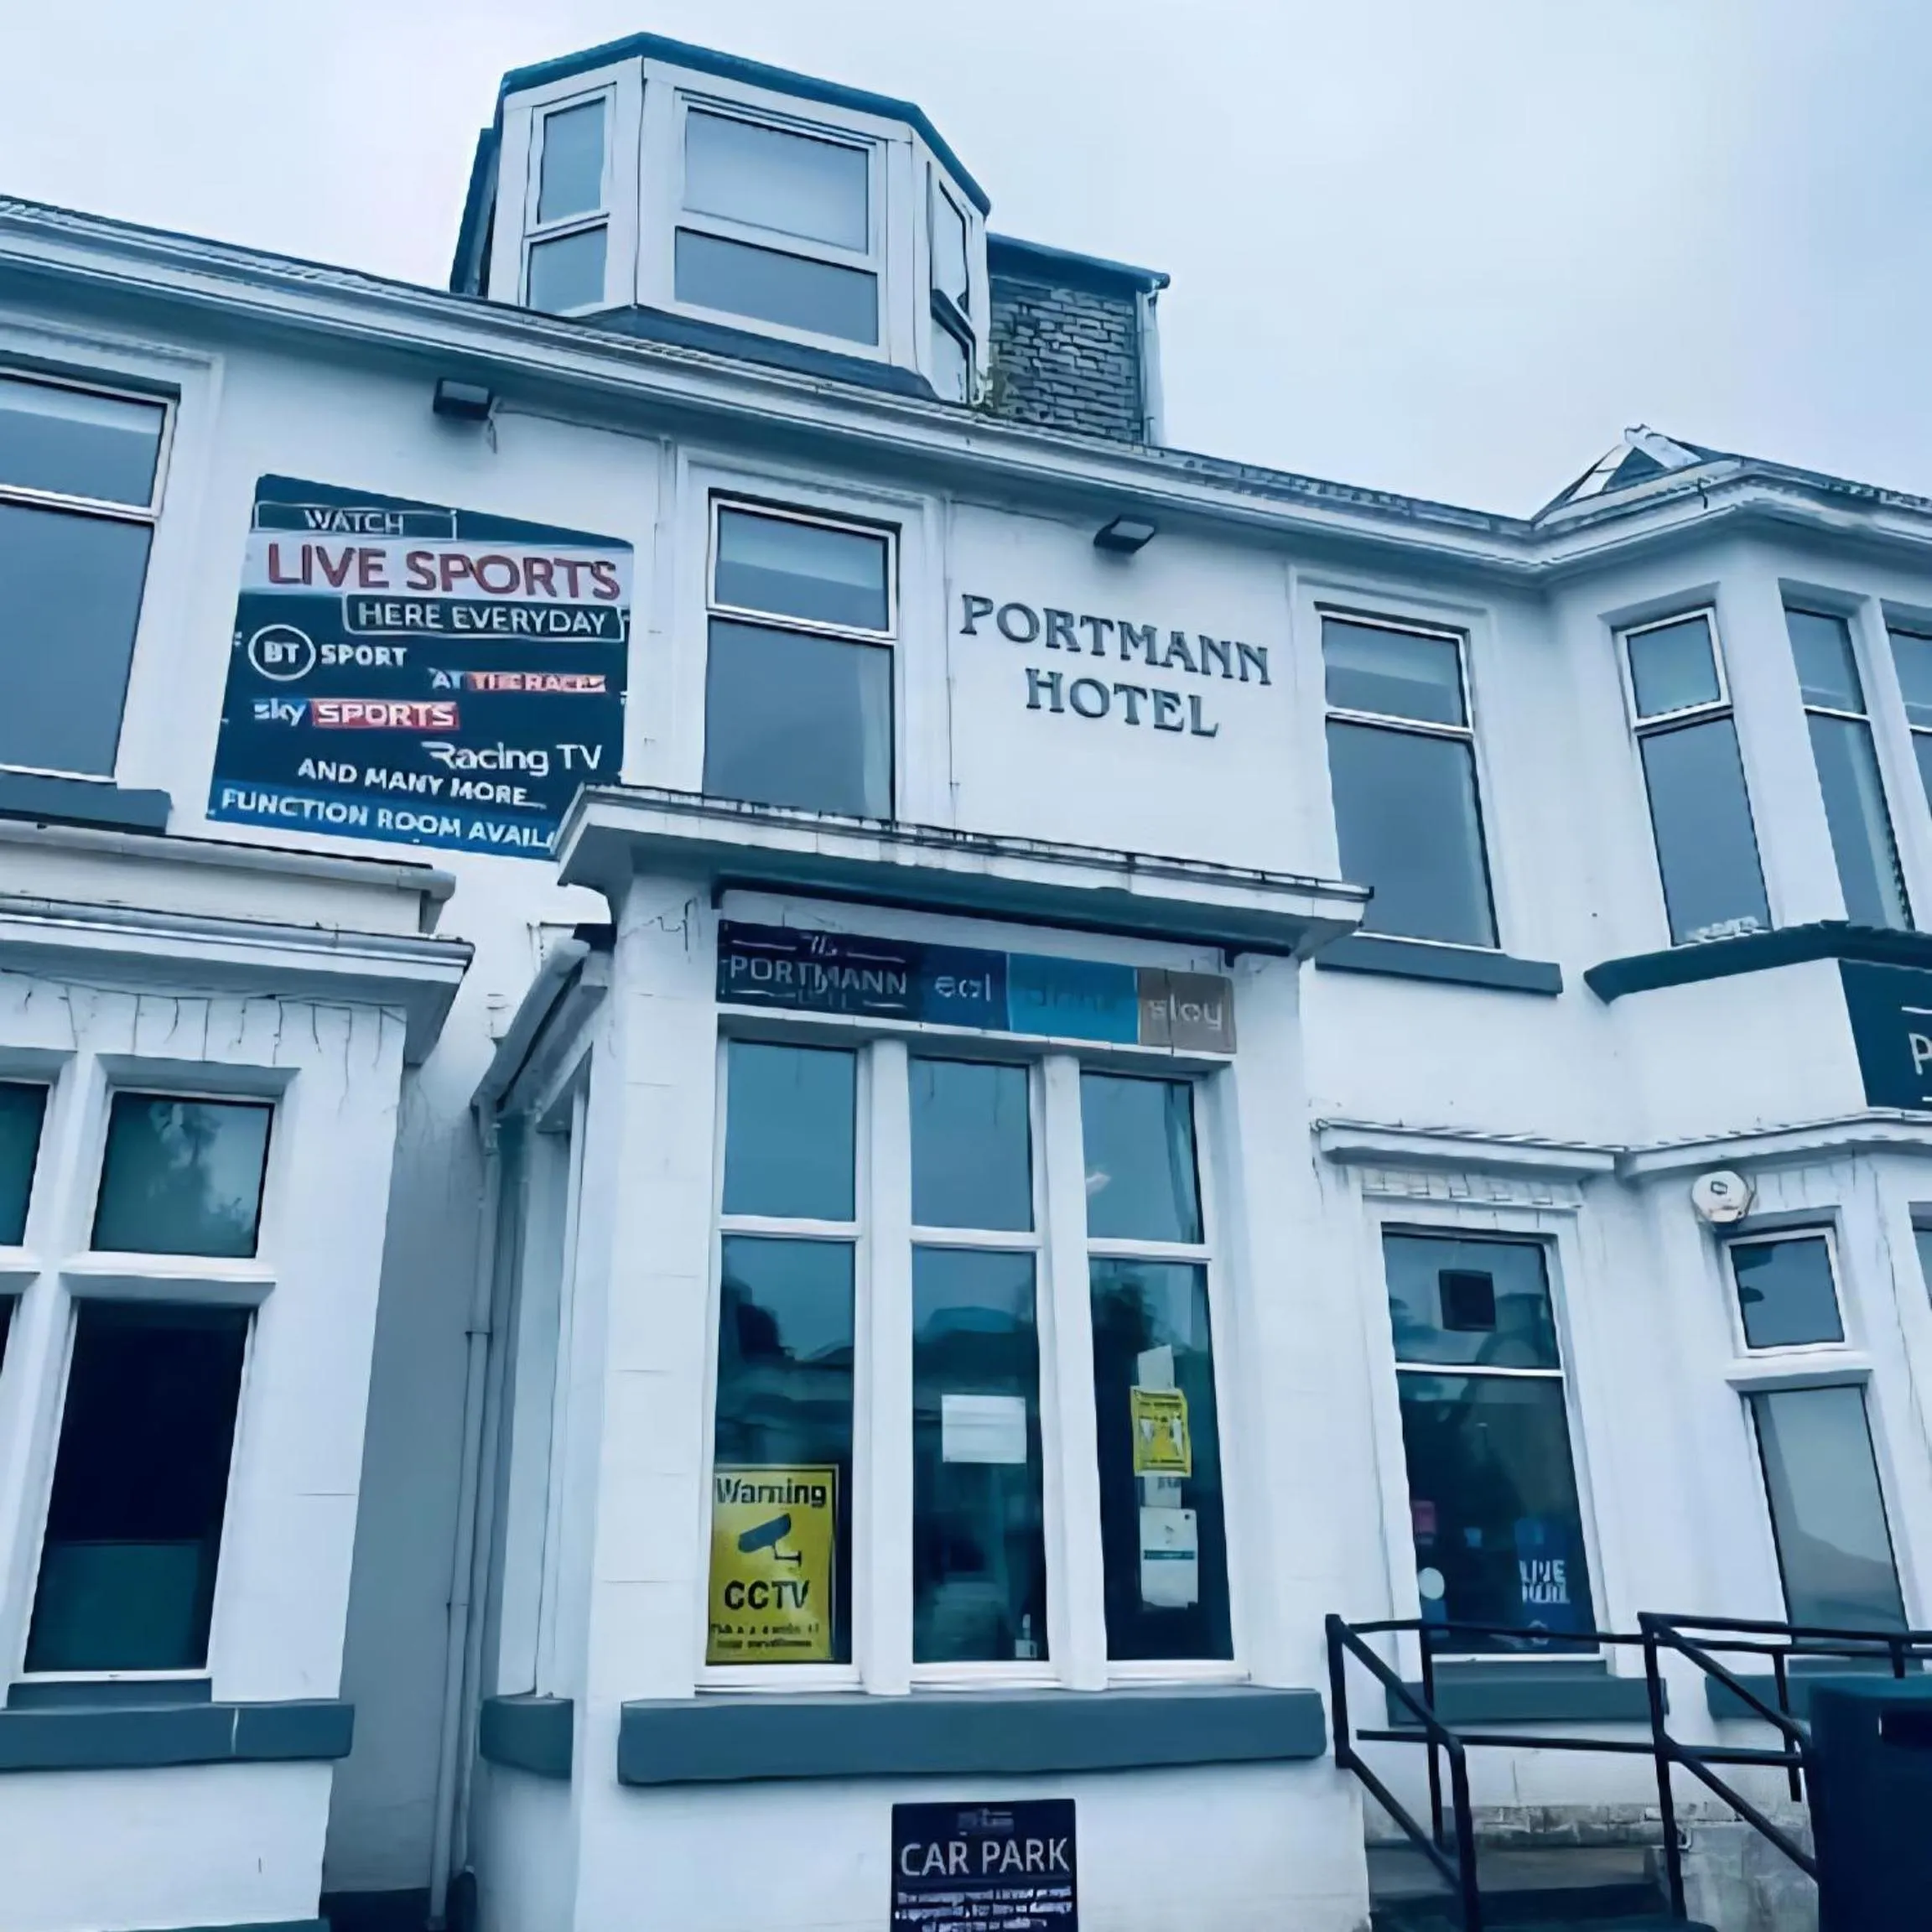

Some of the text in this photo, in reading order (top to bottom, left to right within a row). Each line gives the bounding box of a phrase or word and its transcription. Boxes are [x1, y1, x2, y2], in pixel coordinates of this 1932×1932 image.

[304, 509, 403, 536] WATCH
[267, 543, 621, 600] LIVE SPORTS
[358, 602, 606, 636] HERE EVERYDAY
[263, 641, 408, 667] BT SPORT
[959, 594, 1271, 685] PORTMANN
[254, 698, 455, 728] sky SPORTS
[1025, 667, 1219, 737] HOTEL
[298, 757, 357, 784] AND
[364, 767, 444, 797] MANY
[421, 741, 603, 776] Racing TV
[221, 788, 367, 827] FUNCTION
[377, 809, 461, 838] ROOM
[730, 954, 906, 995] PORTMANN
[716, 1478, 826, 1508] Warning
[724, 1580, 810, 1610] CCTV
[901, 1837, 1070, 1877] CAR PARK
